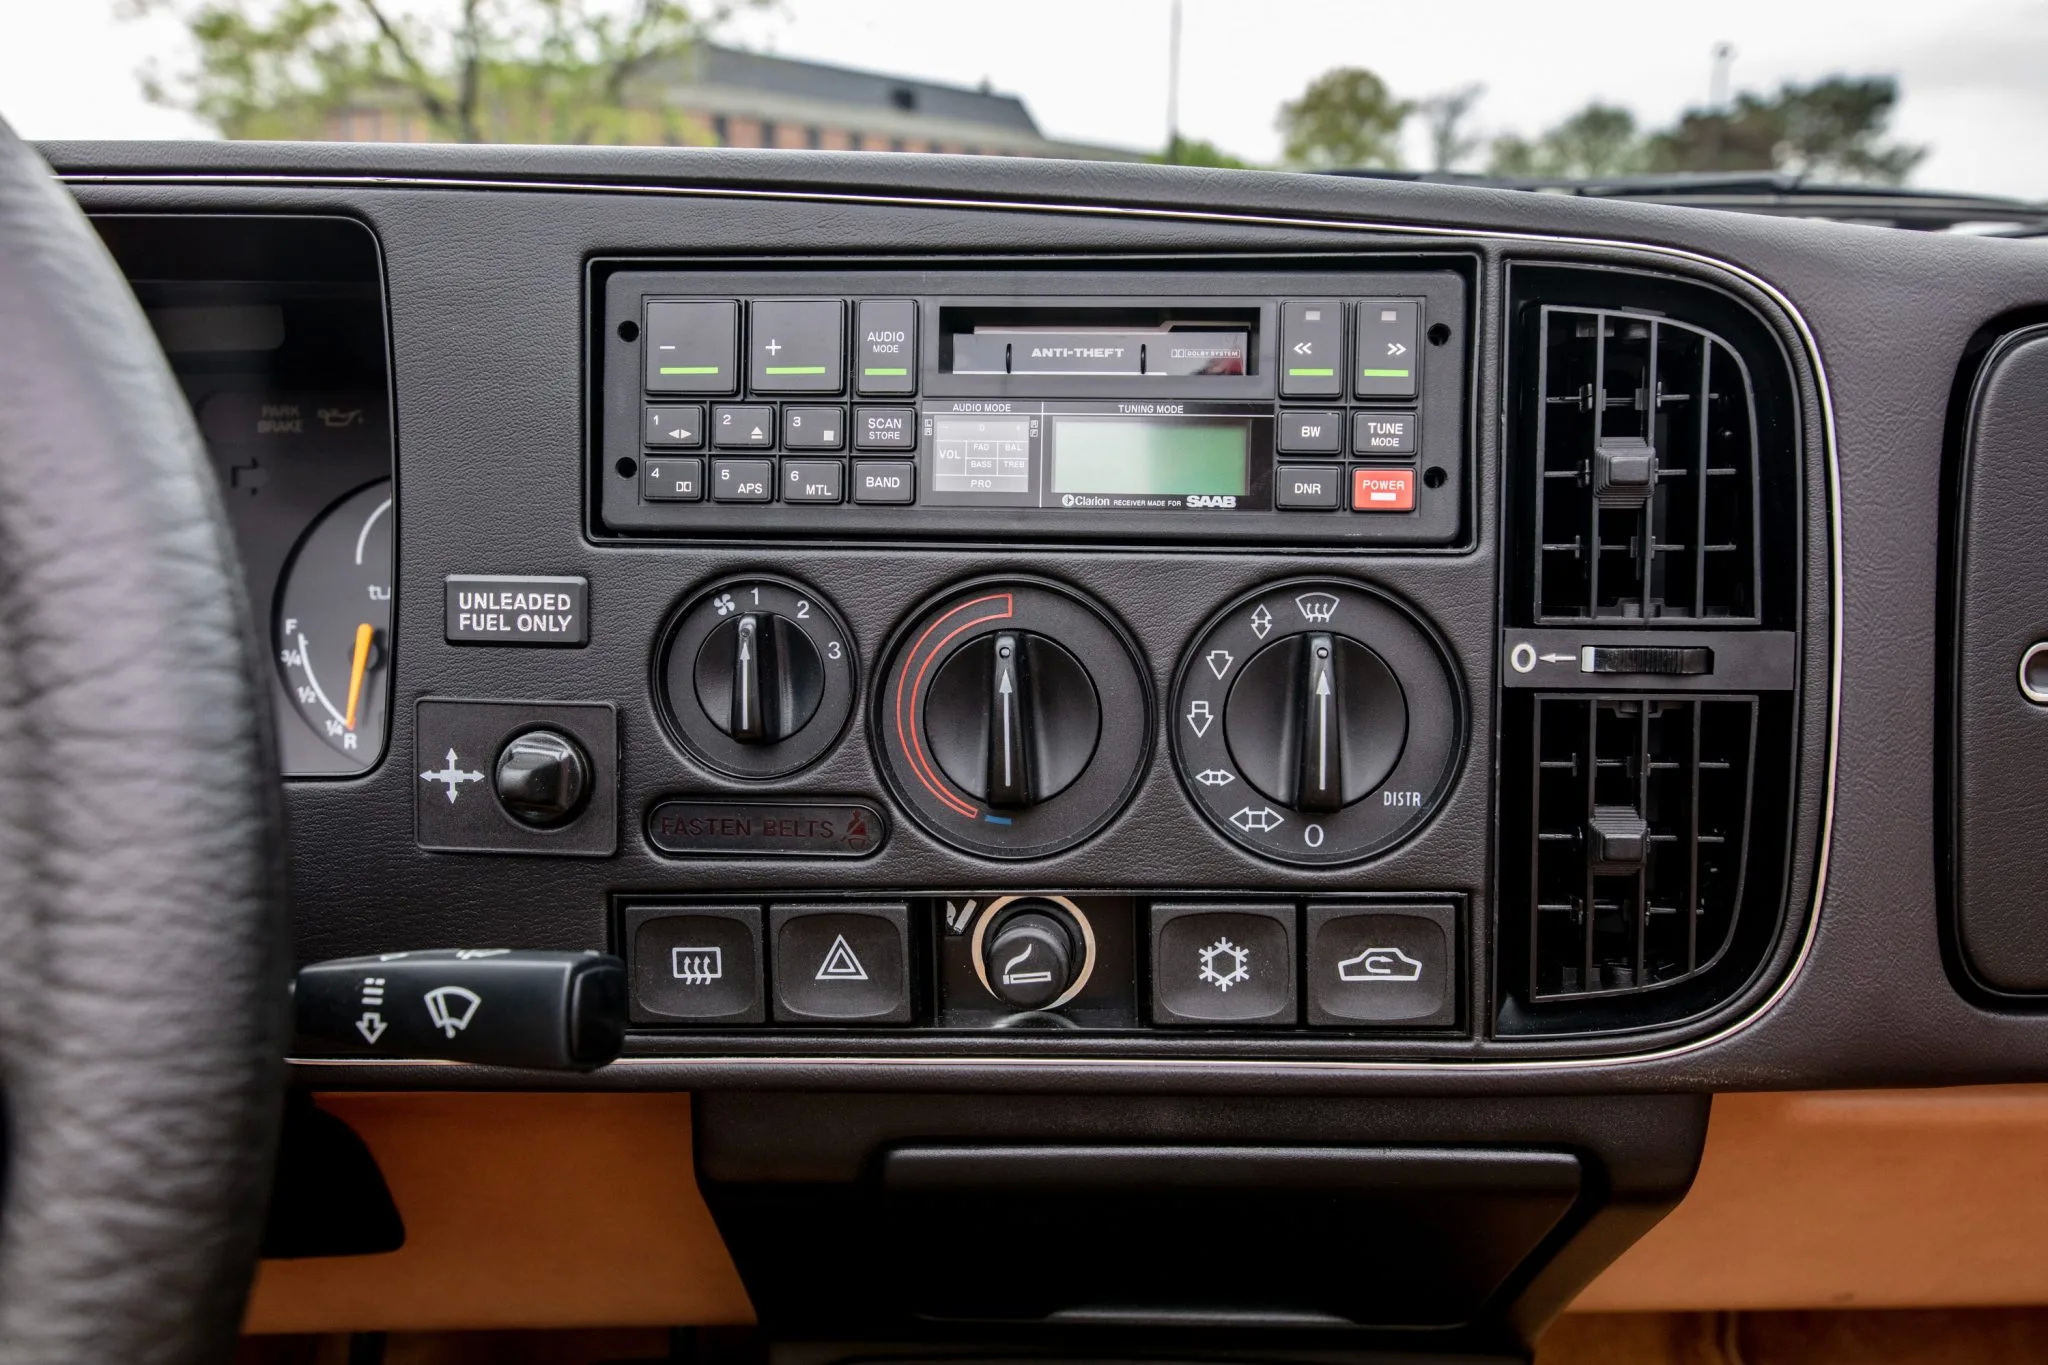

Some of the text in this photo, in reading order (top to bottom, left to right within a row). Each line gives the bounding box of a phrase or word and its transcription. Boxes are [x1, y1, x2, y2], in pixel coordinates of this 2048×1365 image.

[867, 331, 905, 343] AUDIO
[872, 345, 899, 353] MODE
[1031, 347, 1125, 358] ANTI-THEFT
[952, 403, 1012, 412] AUDIO MODE
[1118, 404, 1184, 414] TUNING MODE
[653, 415, 660, 425] 1
[722, 414, 732, 425] 2
[792, 416, 802, 427] 3
[867, 418, 902, 429] SCAN
[1301, 426, 1321, 438] BW
[1368, 422, 1404, 435] TUNE
[868, 431, 900, 441] STORE
[973, 443, 990, 451] FAD
[1004, 443, 1022, 452] BAL
[1370, 437, 1400, 447] MODE
[939, 449, 961, 459] VOL
[970, 460, 992, 468] BASS
[1004, 460, 1025, 468] TREB
[651, 468, 660, 479] 4
[721, 469, 730, 480] 5
[790, 470, 799, 481] 6
[865, 476, 900, 488] BAND
[970, 479, 992, 488] PRO
[1362, 479, 1405, 491] POWER
[737, 483, 763, 494] APS
[805, 485, 832, 496] MTL
[1294, 483, 1321, 495] DNR
[1074, 495, 1110, 507] Clarion
[1113, 499, 1146, 507] RECEIVER
[1186, 495, 1237, 509] SAAB
[458, 591, 572, 611] UNLEADED
[750, 587, 759, 605] 1
[796, 600, 810, 619] 2
[285, 618, 298, 635] F
[458, 613, 573, 633] FUEL ONLY
[828, 641, 842, 660] 3
[343, 732, 357, 750] R
[1383, 791, 1422, 808] DISTR
[660, 816, 834, 839] FASTEN BELTS
